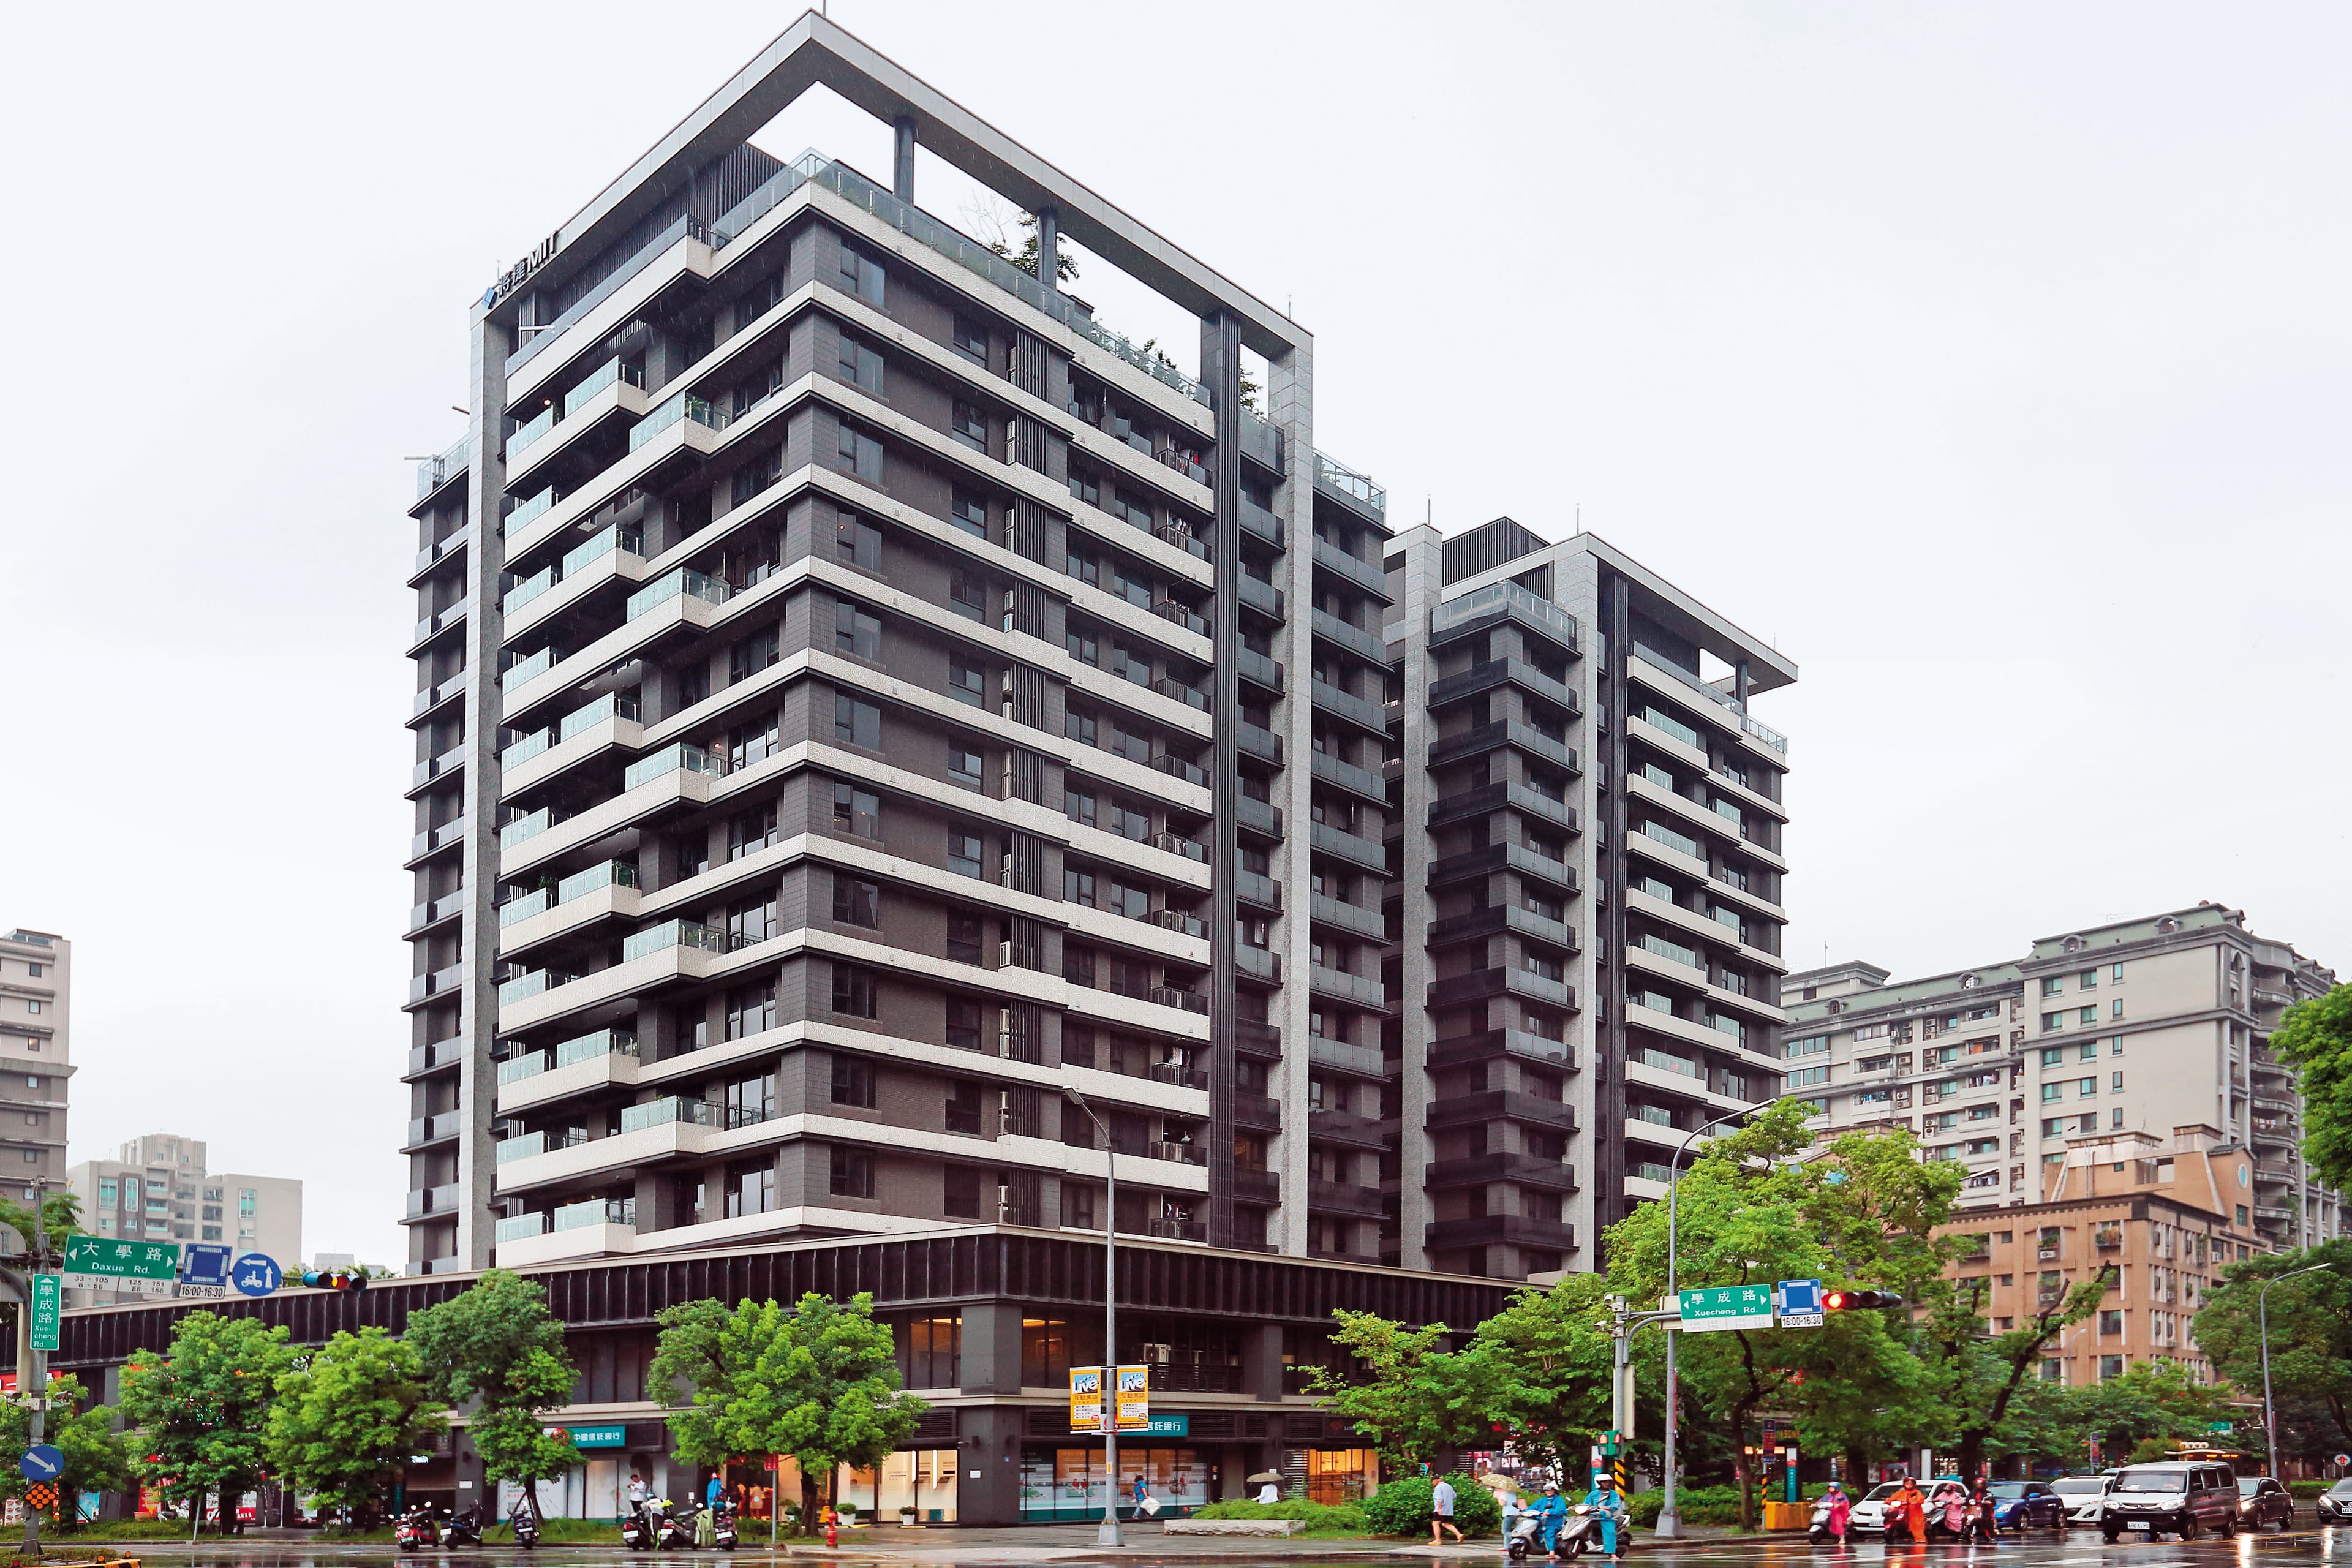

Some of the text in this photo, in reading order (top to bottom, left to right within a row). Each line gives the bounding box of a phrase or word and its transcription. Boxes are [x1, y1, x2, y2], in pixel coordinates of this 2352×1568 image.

[81, 1241, 162, 1261] 大學路
[92, 1262, 151, 1275] Daxue Rd.
[181, 1286, 224, 1297] 16:00-16:30
[1691, 1289, 1756, 1305] 學成路
[39, 1284, 54, 1323] 學成路
[1782, 1316, 1822, 1326] 16:00-16:30
[1072, 1378, 1099, 1394] Live
[1118, 1376, 1147, 1392] Live
